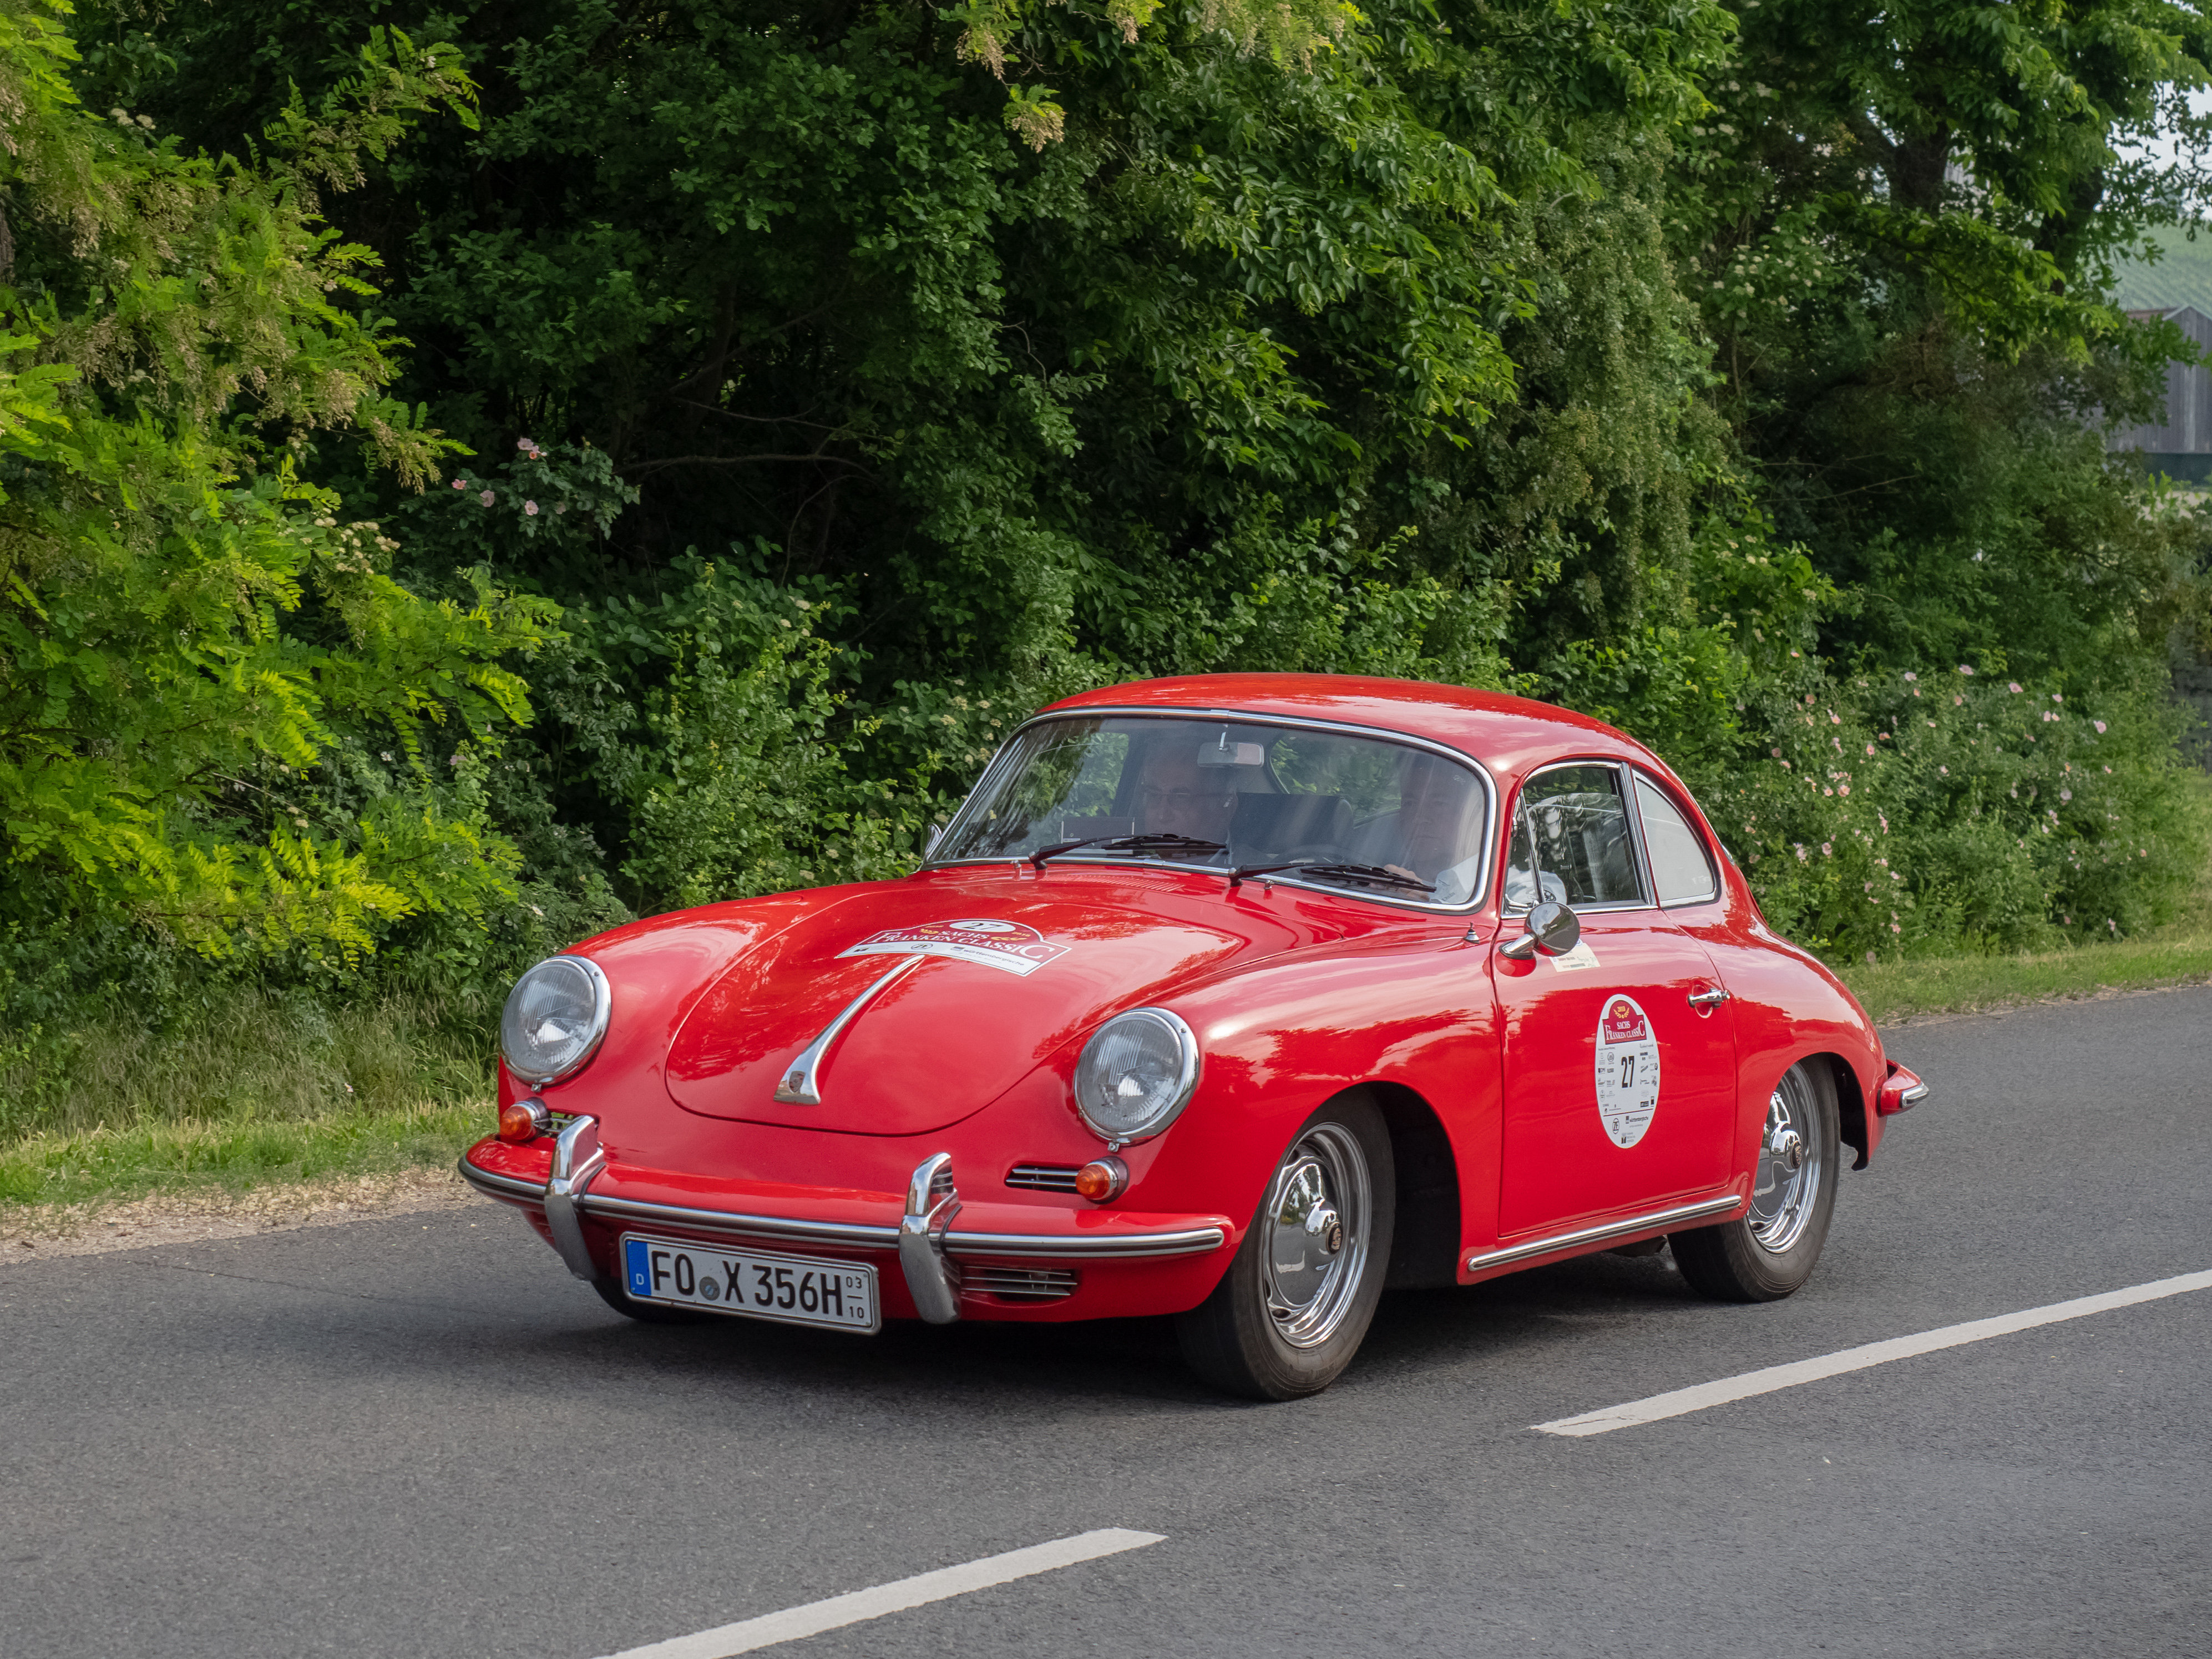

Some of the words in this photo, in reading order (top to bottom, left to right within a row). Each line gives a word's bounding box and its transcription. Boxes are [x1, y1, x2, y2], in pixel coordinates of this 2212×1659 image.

[938, 930, 990, 939] SACHS
[867, 932, 958, 943] FRANKEN
[958, 938, 1055, 959] CLASSIC
[1617, 1021, 1631, 1030] SACHS
[1621, 1055, 1635, 1088] 27
[636, 1273, 644, 1286] D
[651, 1250, 696, 1296] FO
[722, 1260, 745, 1303] X
[752, 1264, 843, 1316] 356H
[846, 1276, 862, 1289] 03
[849, 1306, 864, 1319] 10
